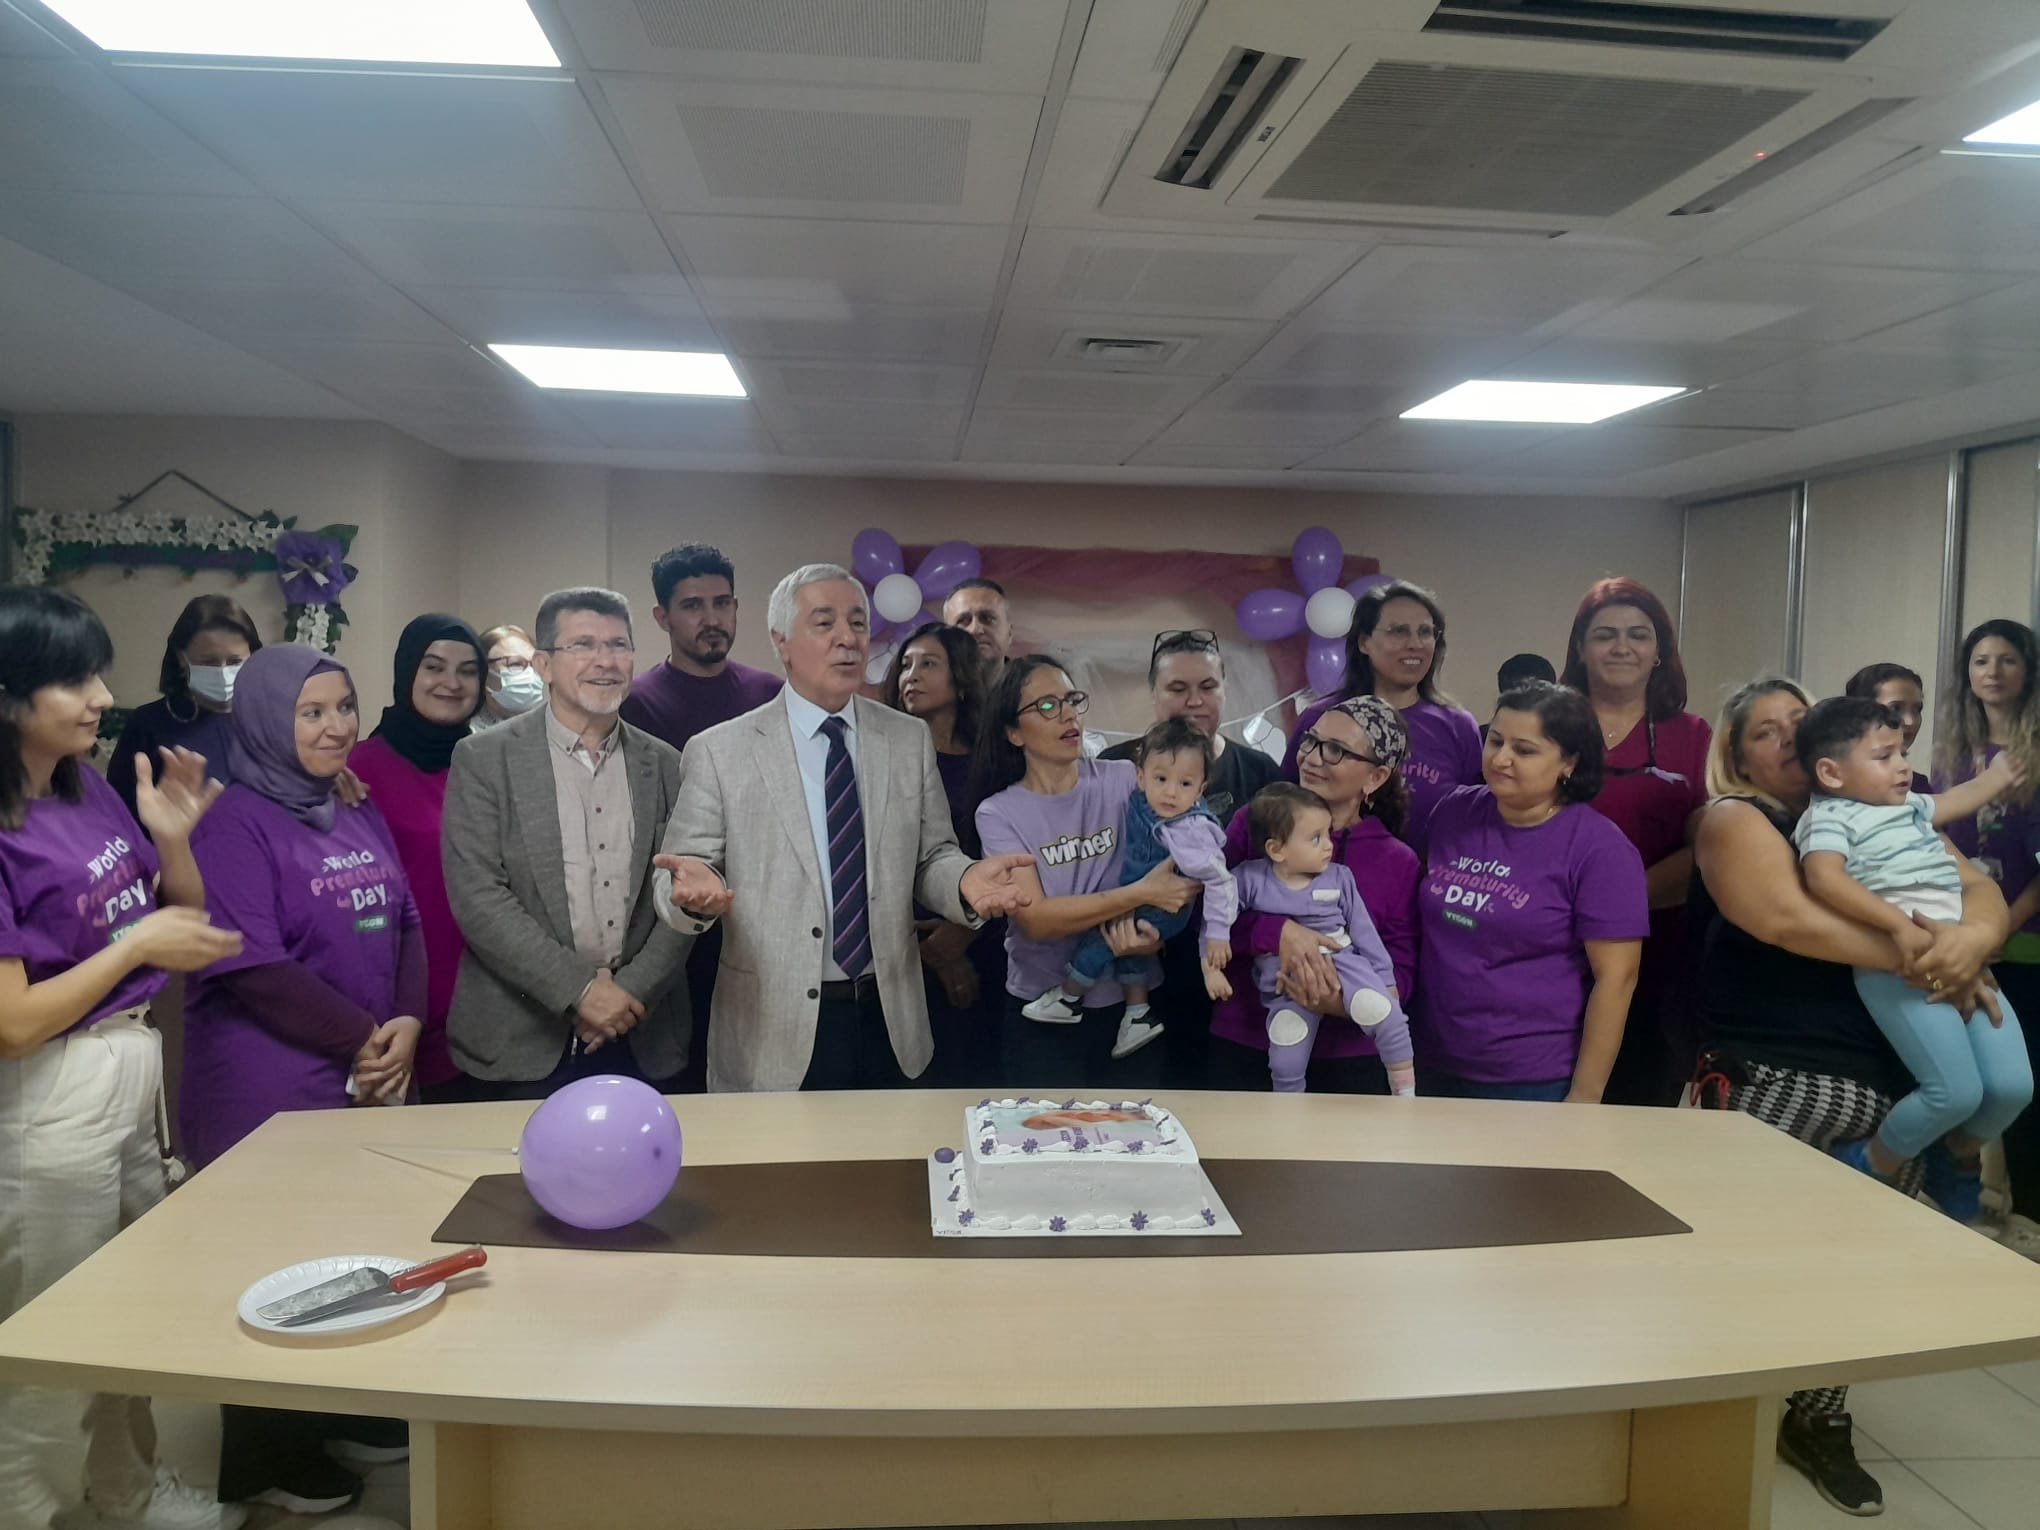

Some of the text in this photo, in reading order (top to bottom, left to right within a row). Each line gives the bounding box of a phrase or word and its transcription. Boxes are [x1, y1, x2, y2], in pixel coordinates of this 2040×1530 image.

[87, 836, 131, 880] World
[1040, 826, 1114, 867] winner
[1457, 856, 1511, 877] World
[105, 878, 147, 924] Day
[350, 883, 387, 912] Day
[1444, 884, 1491, 913] Day
